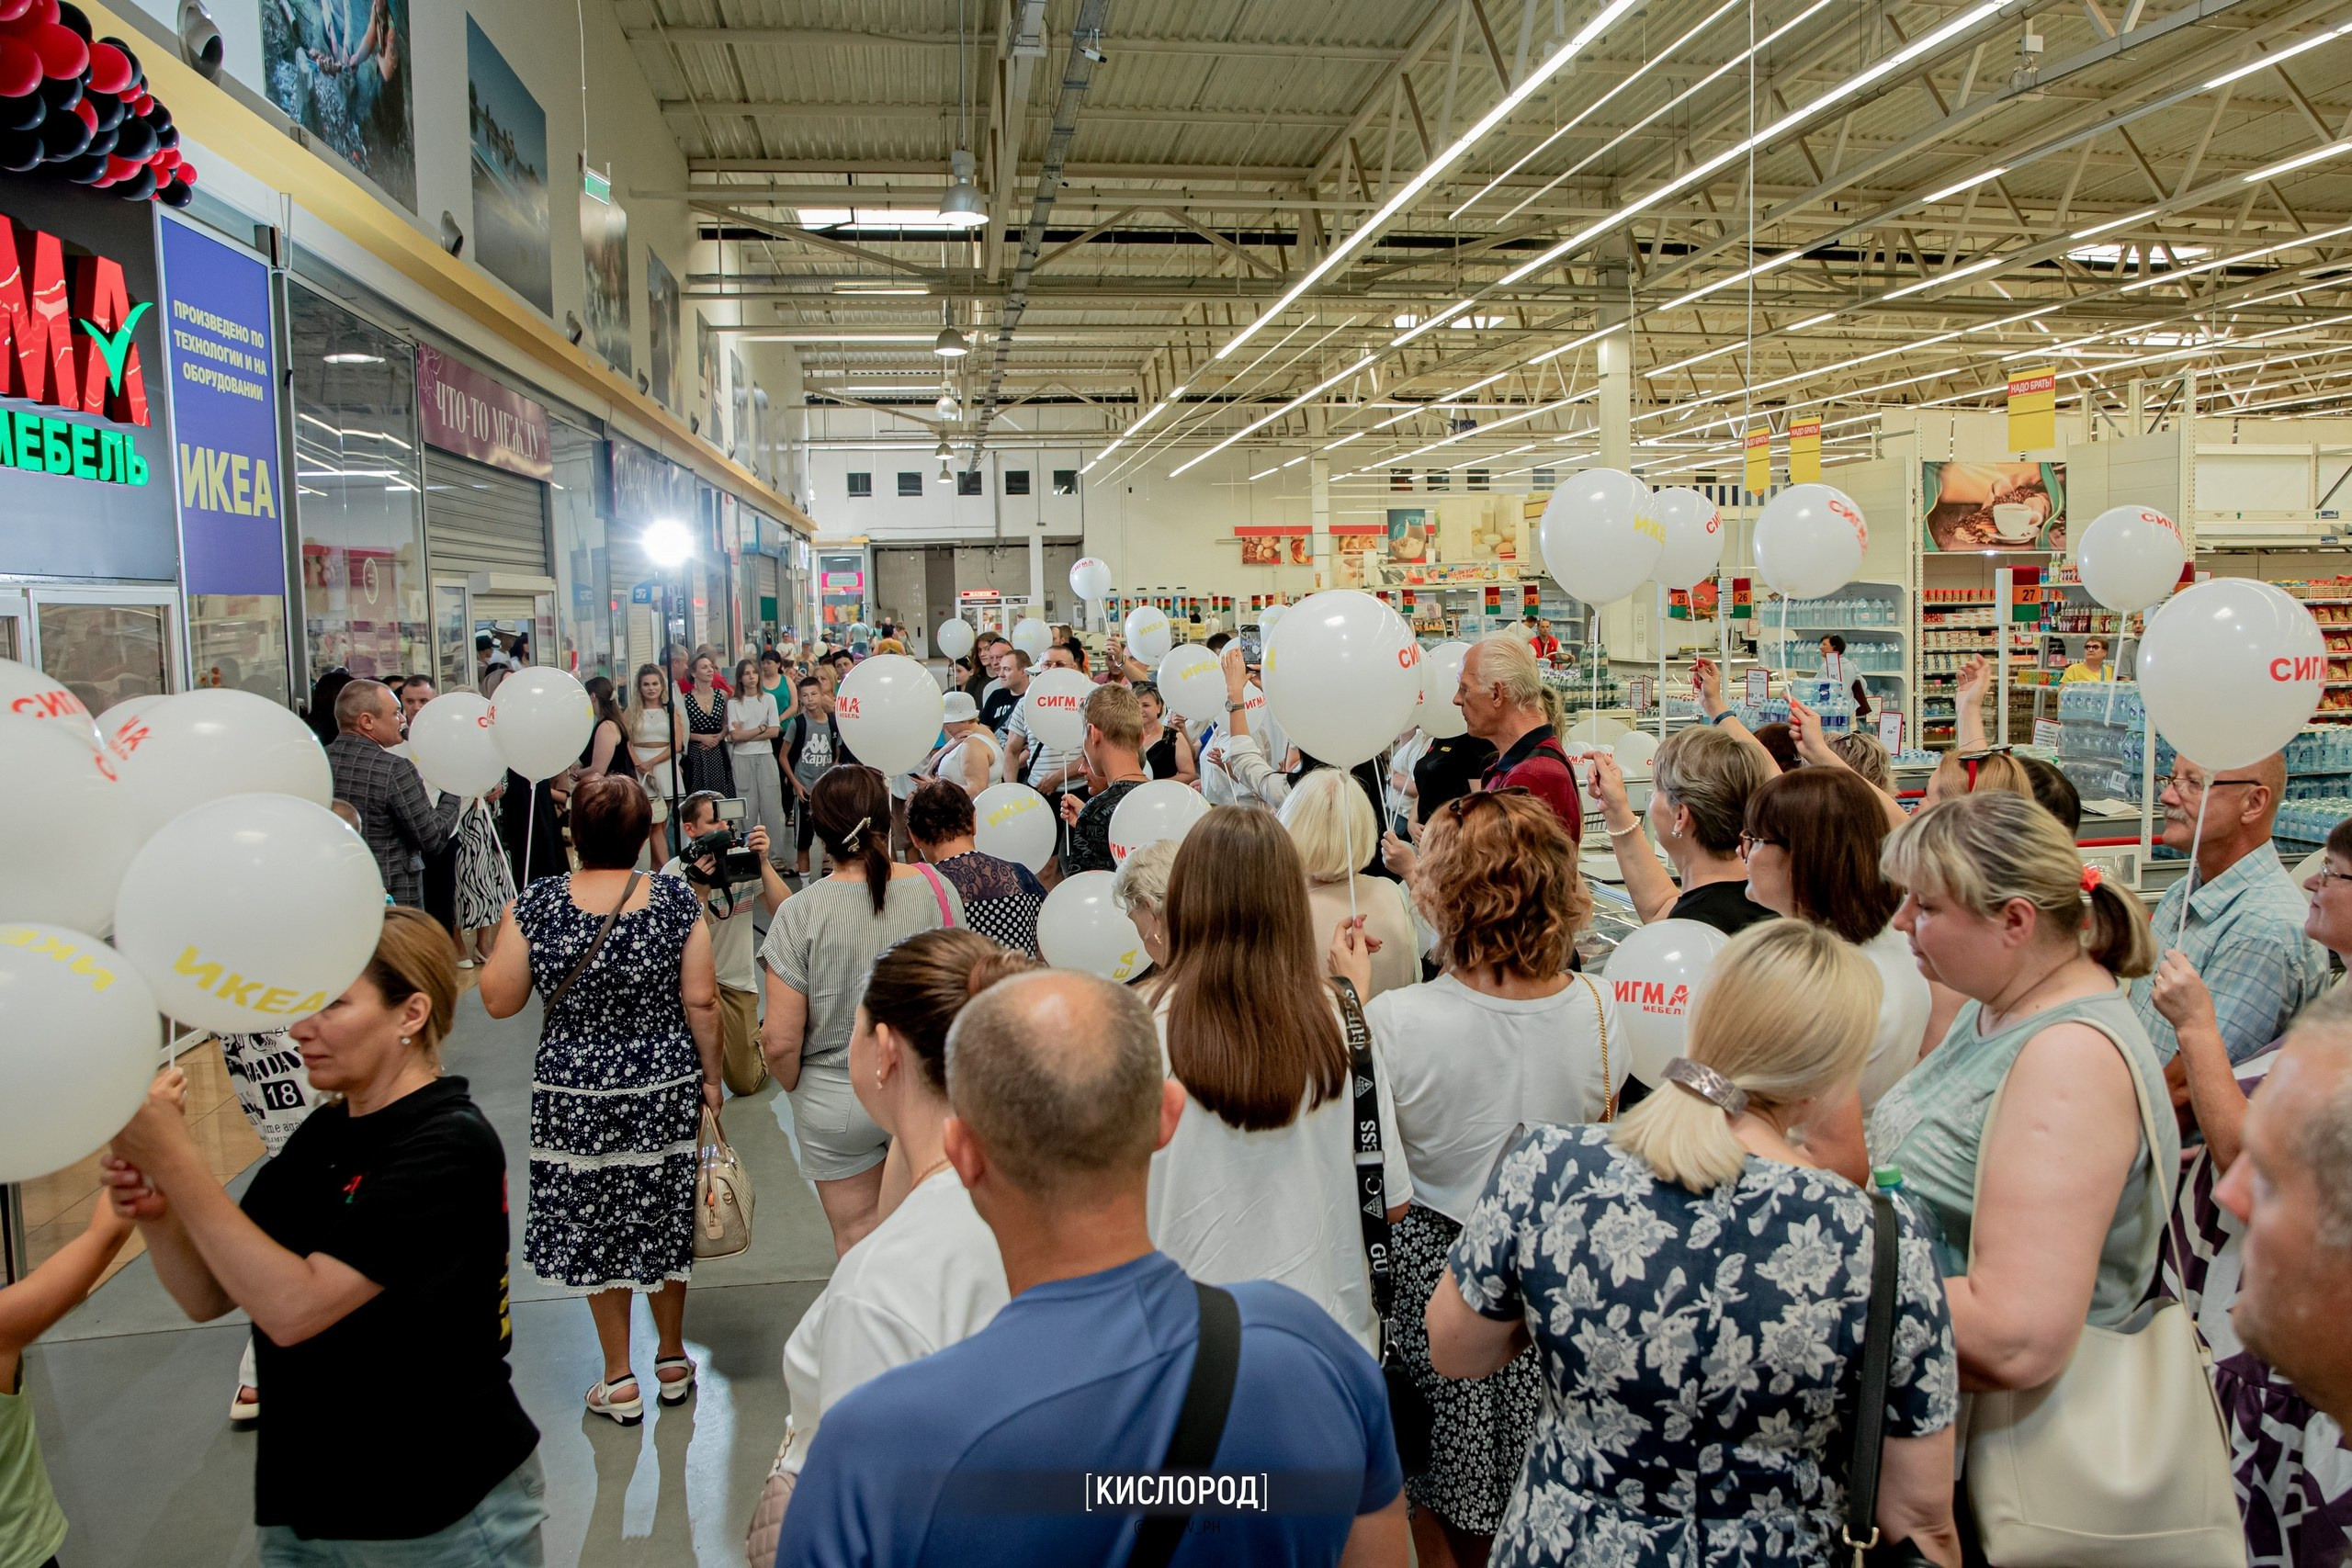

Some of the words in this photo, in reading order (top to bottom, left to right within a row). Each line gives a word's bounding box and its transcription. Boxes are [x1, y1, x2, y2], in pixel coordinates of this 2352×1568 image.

[174, 299, 249, 341] ПРОИЗВЕДЕНО
[250, 330, 265, 349] ПО
[174, 329, 243, 369] ТЕХНОЛОГИИ
[244, 354, 253, 372] И
[254, 357, 268, 377] НА
[183, 362, 264, 401] ОБОРУДОВАНИИ
[2010, 382, 2029, 394] НАДО
[2030, 377, 2052, 390] БРАТЬ!
[435, 380, 489, 442] ЧТО-ТО
[492, 406, 539, 459] МЕЖДУ
[1791, 428, 1804, 437] НАДО
[181, 443, 276, 519] ИКЕА
[1677, 594, 1686, 604] 25
[1737, 592, 1748, 603] 26
[2022, 589, 2035, 602] 27
[1180, 660, 1219, 681] ИКЕА
[802, 752, 832, 767] Kappa
[986, 796, 1039, 827] ИКЕА
[174, 945, 328, 1014] ИКЕА
[1614, 980, 1690, 1008] ИГМА
[1643, 1005, 1685, 1015] МЕБЕЛ
[267, 1082, 298, 1108] 18
[1360, 1119, 1377, 1152] ESS
